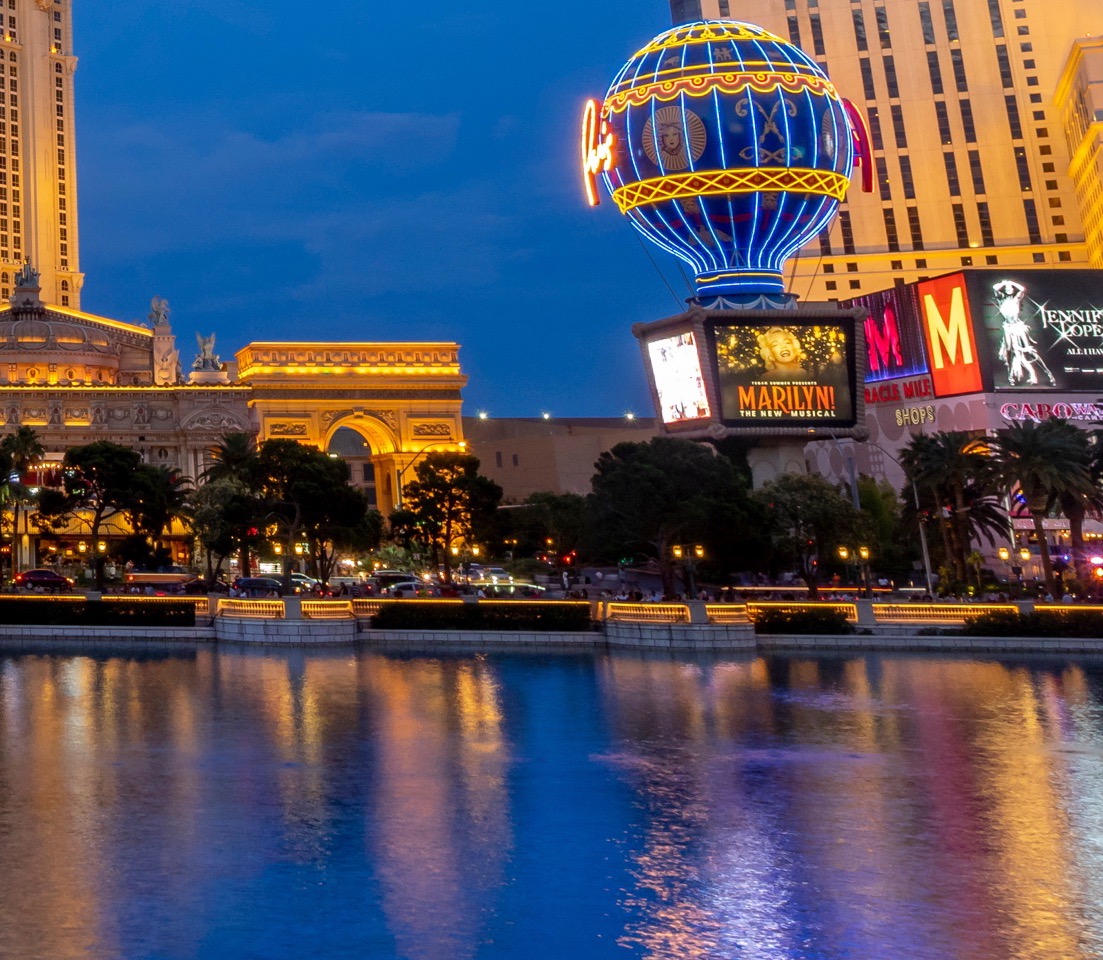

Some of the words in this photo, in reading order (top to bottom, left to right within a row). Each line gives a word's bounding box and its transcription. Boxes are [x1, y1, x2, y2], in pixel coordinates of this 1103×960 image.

[923, 286, 974, 370] M
[738, 386, 835, 413] MARILYN!
[902, 378, 932, 399] MILE
[895, 405, 935, 427] SHOPS
